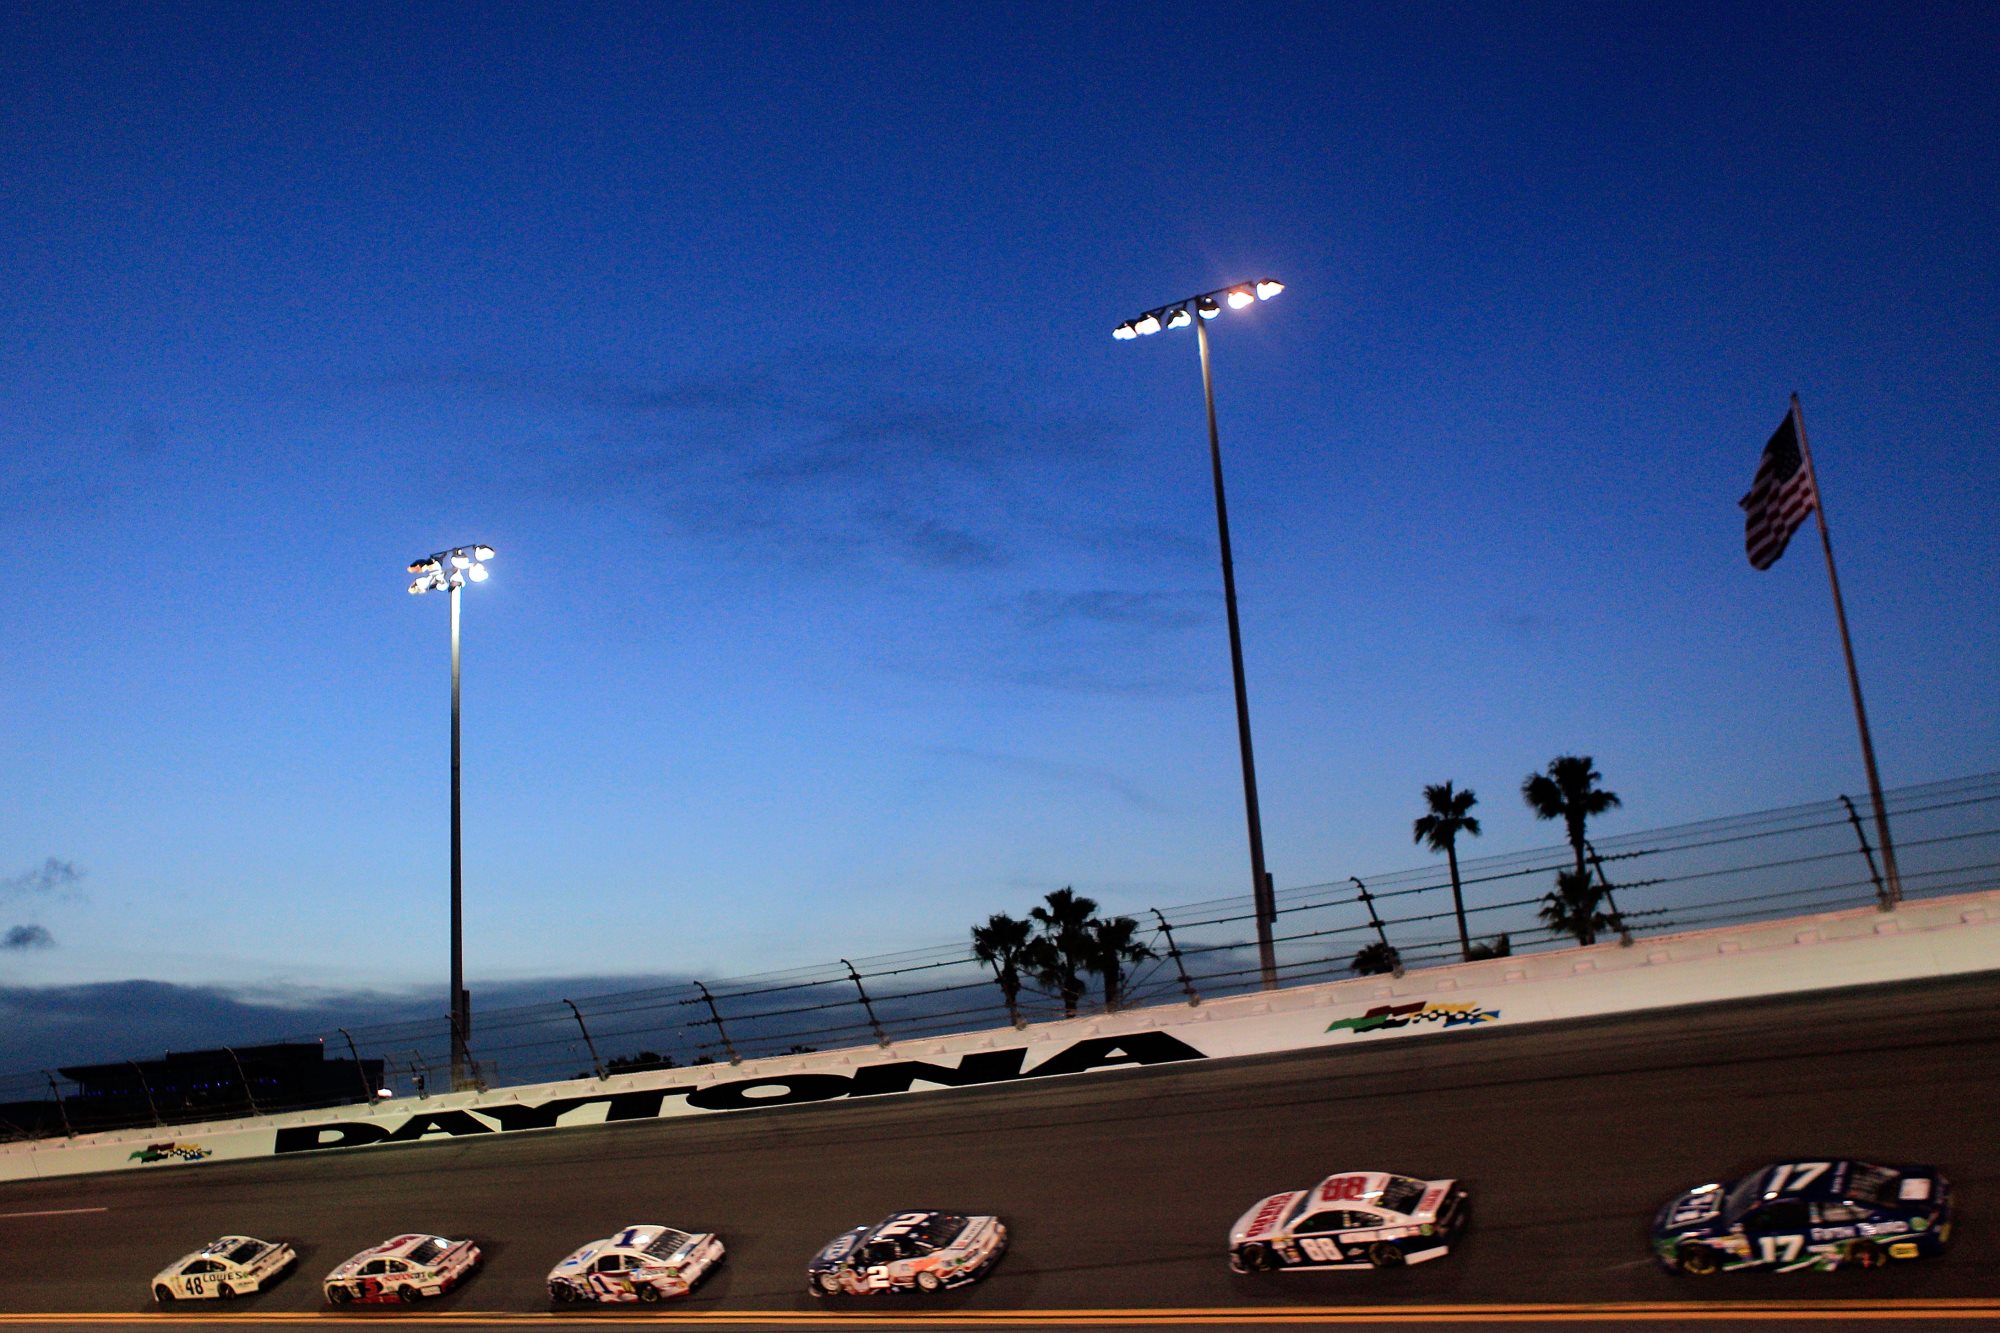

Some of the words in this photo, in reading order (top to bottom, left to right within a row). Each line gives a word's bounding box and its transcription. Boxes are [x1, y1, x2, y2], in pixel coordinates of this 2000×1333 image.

[275, 1031, 1210, 1153] DAYTONA
[1321, 1176, 1367, 1201] 88
[1763, 1161, 1832, 1195] 17
[876, 1212, 929, 1236] 2
[614, 1228, 638, 1248] 1
[1300, 1238, 1344, 1261] 88
[1758, 1233, 1804, 1262] 17
[185, 1277, 204, 1295] 48
[592, 1275, 613, 1294] 1
[866, 1265, 890, 1288] 2
